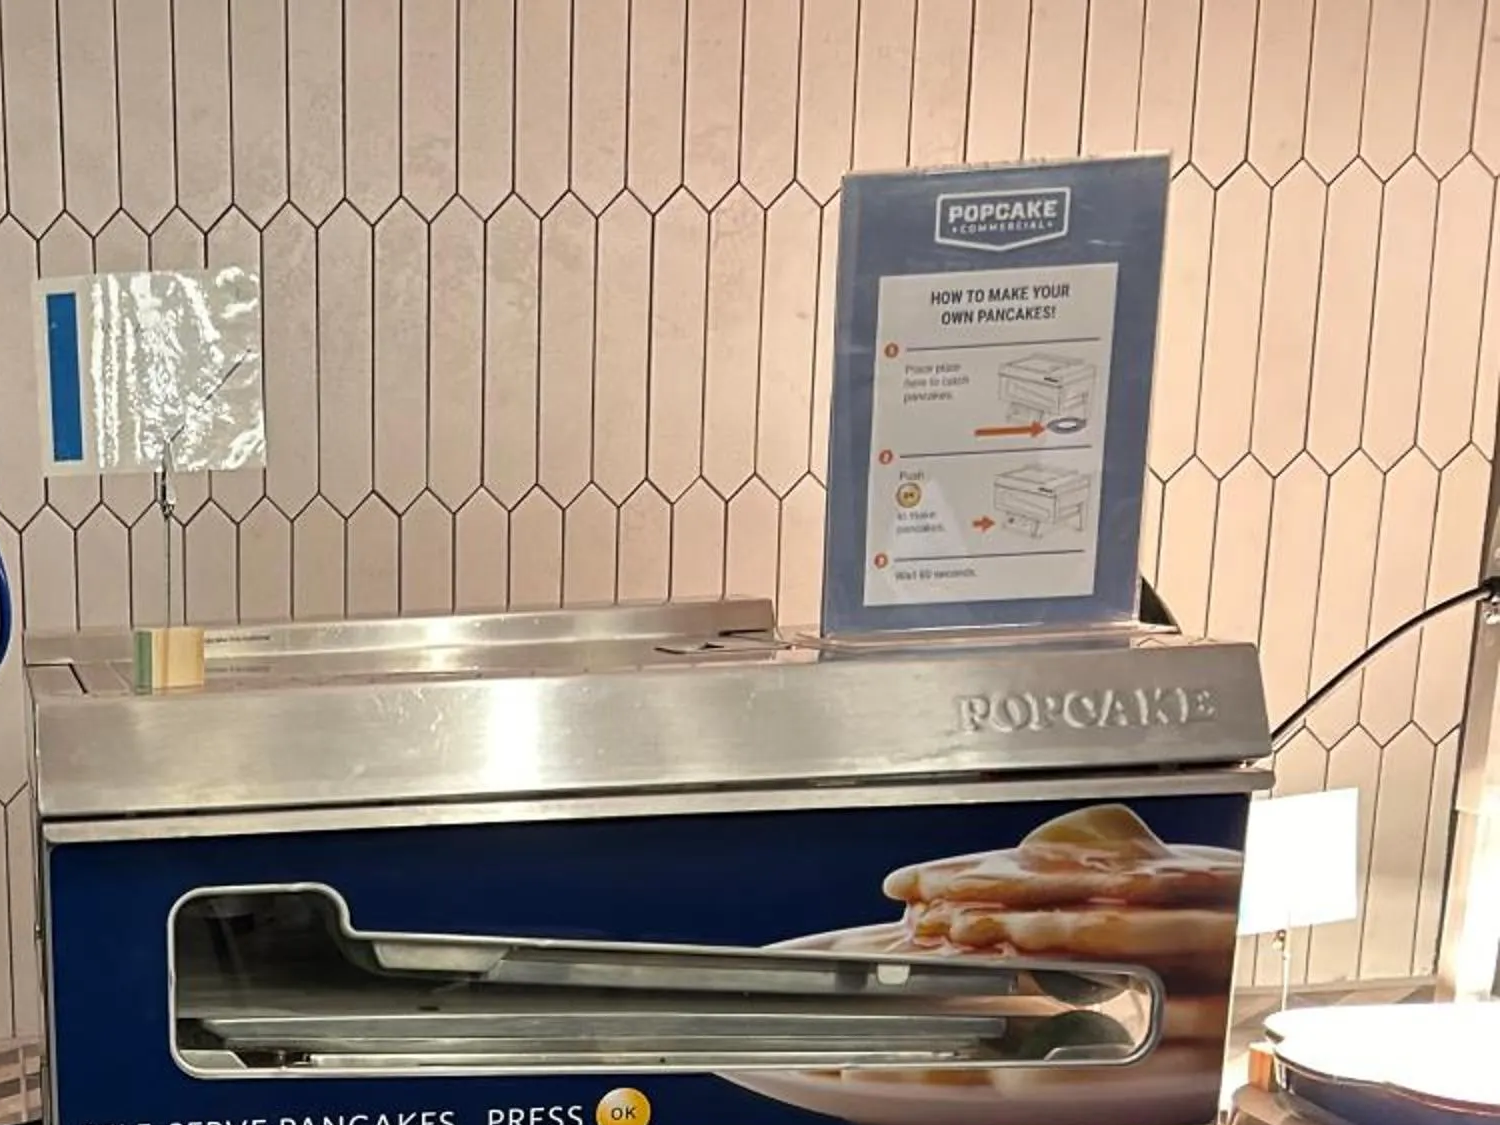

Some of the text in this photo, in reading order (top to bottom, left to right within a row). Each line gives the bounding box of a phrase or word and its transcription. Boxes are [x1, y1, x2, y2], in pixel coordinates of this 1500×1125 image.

[948, 200, 1058, 223] POPCAKE
[931, 284, 1070, 306] HOW TO MAKE YOUR
[941, 306, 1057, 326] OWN PANCAKES!
[611, 1106, 637, 1121] OK
